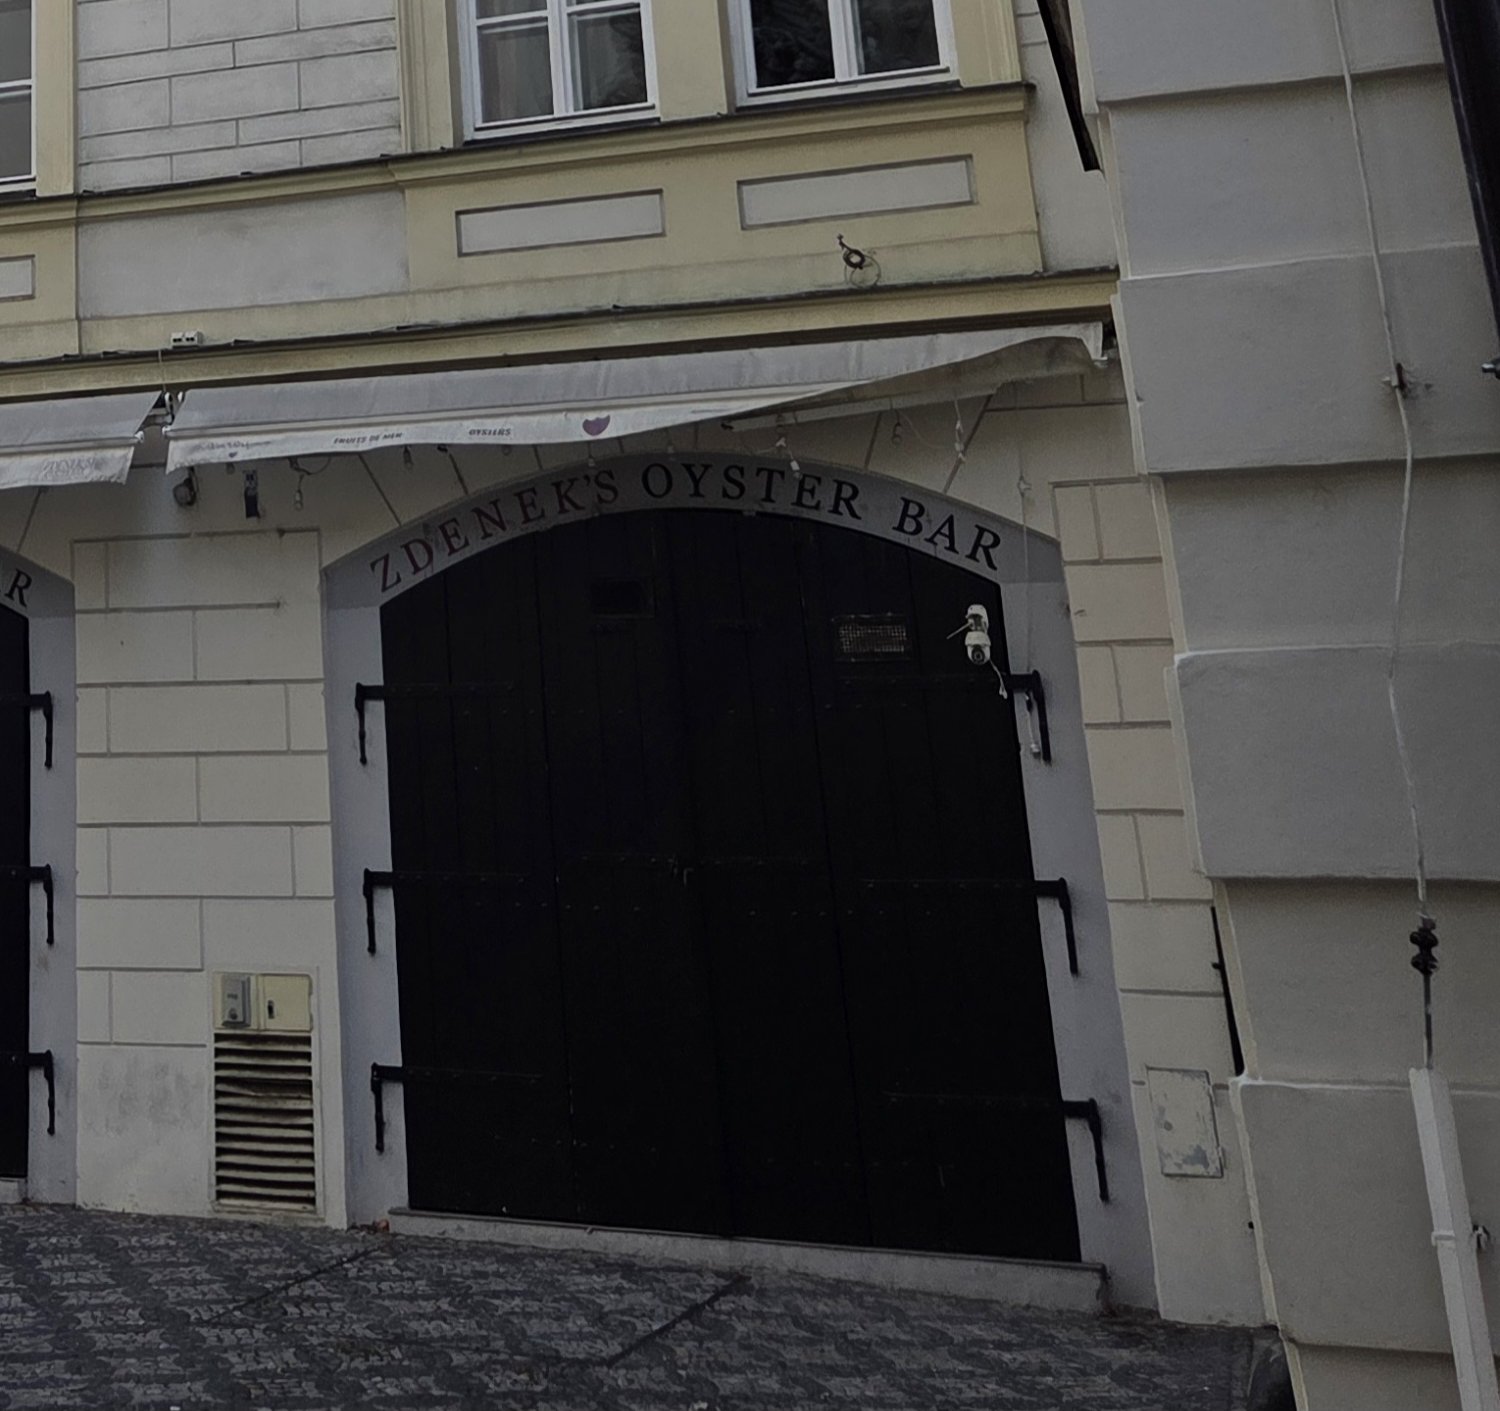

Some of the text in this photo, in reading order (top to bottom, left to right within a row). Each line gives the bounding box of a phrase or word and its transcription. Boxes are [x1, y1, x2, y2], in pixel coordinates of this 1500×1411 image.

[370, 463, 1001, 594] ZDENEK'S OYSTER BAR
